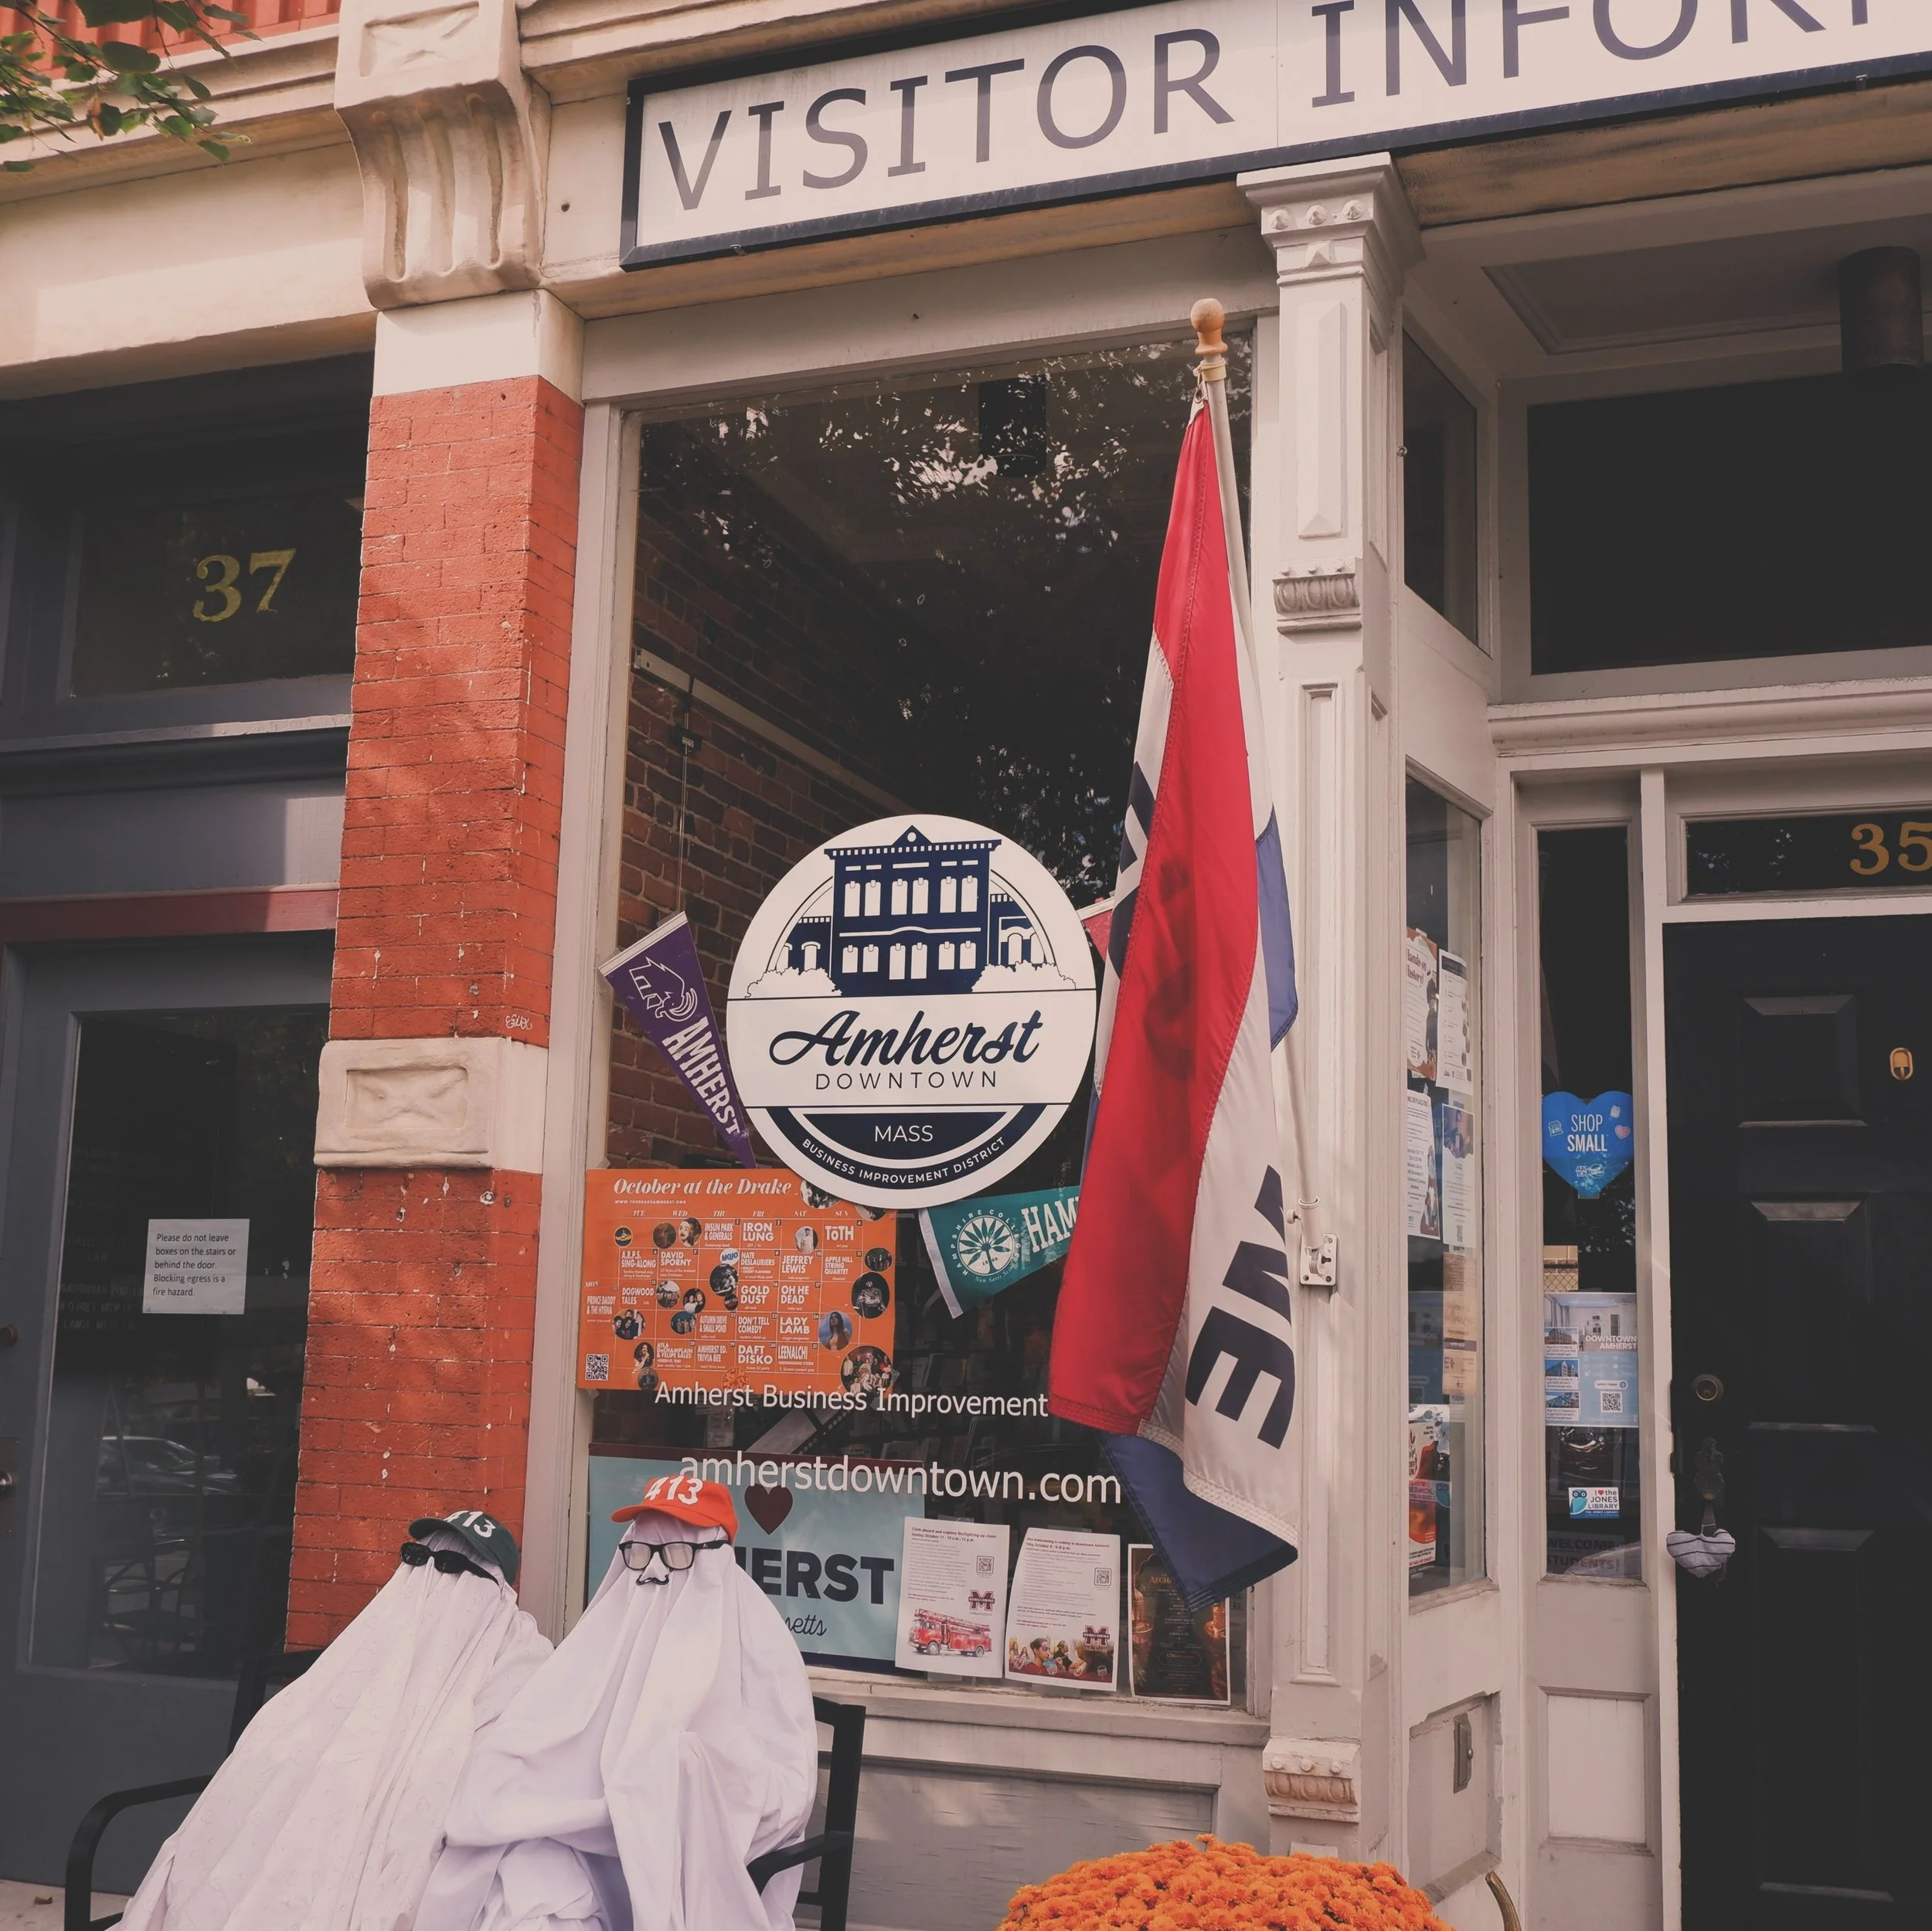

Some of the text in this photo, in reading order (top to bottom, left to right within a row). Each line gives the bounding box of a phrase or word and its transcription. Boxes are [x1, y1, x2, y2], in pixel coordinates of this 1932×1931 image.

[658, 0, 1870, 212] VISITOR INFO
[192, 548, 297, 622] 37
[1849, 821, 1932, 875] 35
[769, 1009, 1043, 1066] Amherst
[662, 1016, 741, 1135] AMHERST
[816, 1070, 996, 1090] DOWNTOWN
[1571, 1114, 1603, 1132] SHOP
[874, 1124, 933, 1142] MASS
[1567, 1134, 1607, 1152] SMALL
[802, 1137, 1005, 1184] BUSINESS IMPROVEMENT DISTRICT
[614, 1178, 792, 1195] October at the Drake
[721, 1223, 733, 1232] PARK
[743, 1222, 772, 1232] IRON
[1021, 1195, 1080, 1253] HAM
[156, 1233, 229, 1242] Please do not leave
[709, 1232, 733, 1241] GENERALS
[743, 1232, 774, 1242] LUNG
[155, 1247, 177, 1256] boxes
[191, 1247, 204, 1256] the
[206, 1247, 226, 1256] stairs
[722, 1252, 738, 1261] MOJO
[782, 1255, 814, 1265] JEFFREY
[155, 1261, 217, 1269] behind the door.
[621, 1260, 656, 1268] SING-ALONG
[782, 1265, 806, 1273] LEWIS
[154, 1274, 185, 1284] Blocking
[153, 1287, 166, 1296] fire
[167, 1288, 194, 1296] hazard.
[622, 1288, 654, 1296] DOGWOOD
[741, 1286, 770, 1295] GOLD
[781, 1286, 809, 1295] OH HE
[587, 1296, 616, 1305] PRINCE DADDY
[622, 1296, 637, 1305] TALES
[741, 1295, 766, 1304] DUST
[781, 1295, 804, 1304] DEAD
[699, 1316, 728, 1324] AUTUMN DRIVE
[738, 1316, 769, 1325] DON'T TELL
[780, 1317, 807, 1326] LADY
[703, 1324, 715, 1333] SMALL
[715, 1324, 727, 1333] POND
[738, 1325, 762, 1334] COMEDY
[780, 1326, 810, 1334] LAMB
[697, 1345, 719, 1353] AMHERST
[738, 1345, 765, 1355] DAFT
[778, 1346, 808, 1360] LEENALCHI
[697, 1354, 721, 1362] TRIVIA BEE
[738, 1355, 773, 1364] DISKO
[655, 1382, 1049, 1419] Amherst Business Improvement
[680, 1450, 1121, 1504] amherstdowntown.com
[644, 1475, 703, 1505] 413
[444, 1509, 496, 1538] 413
